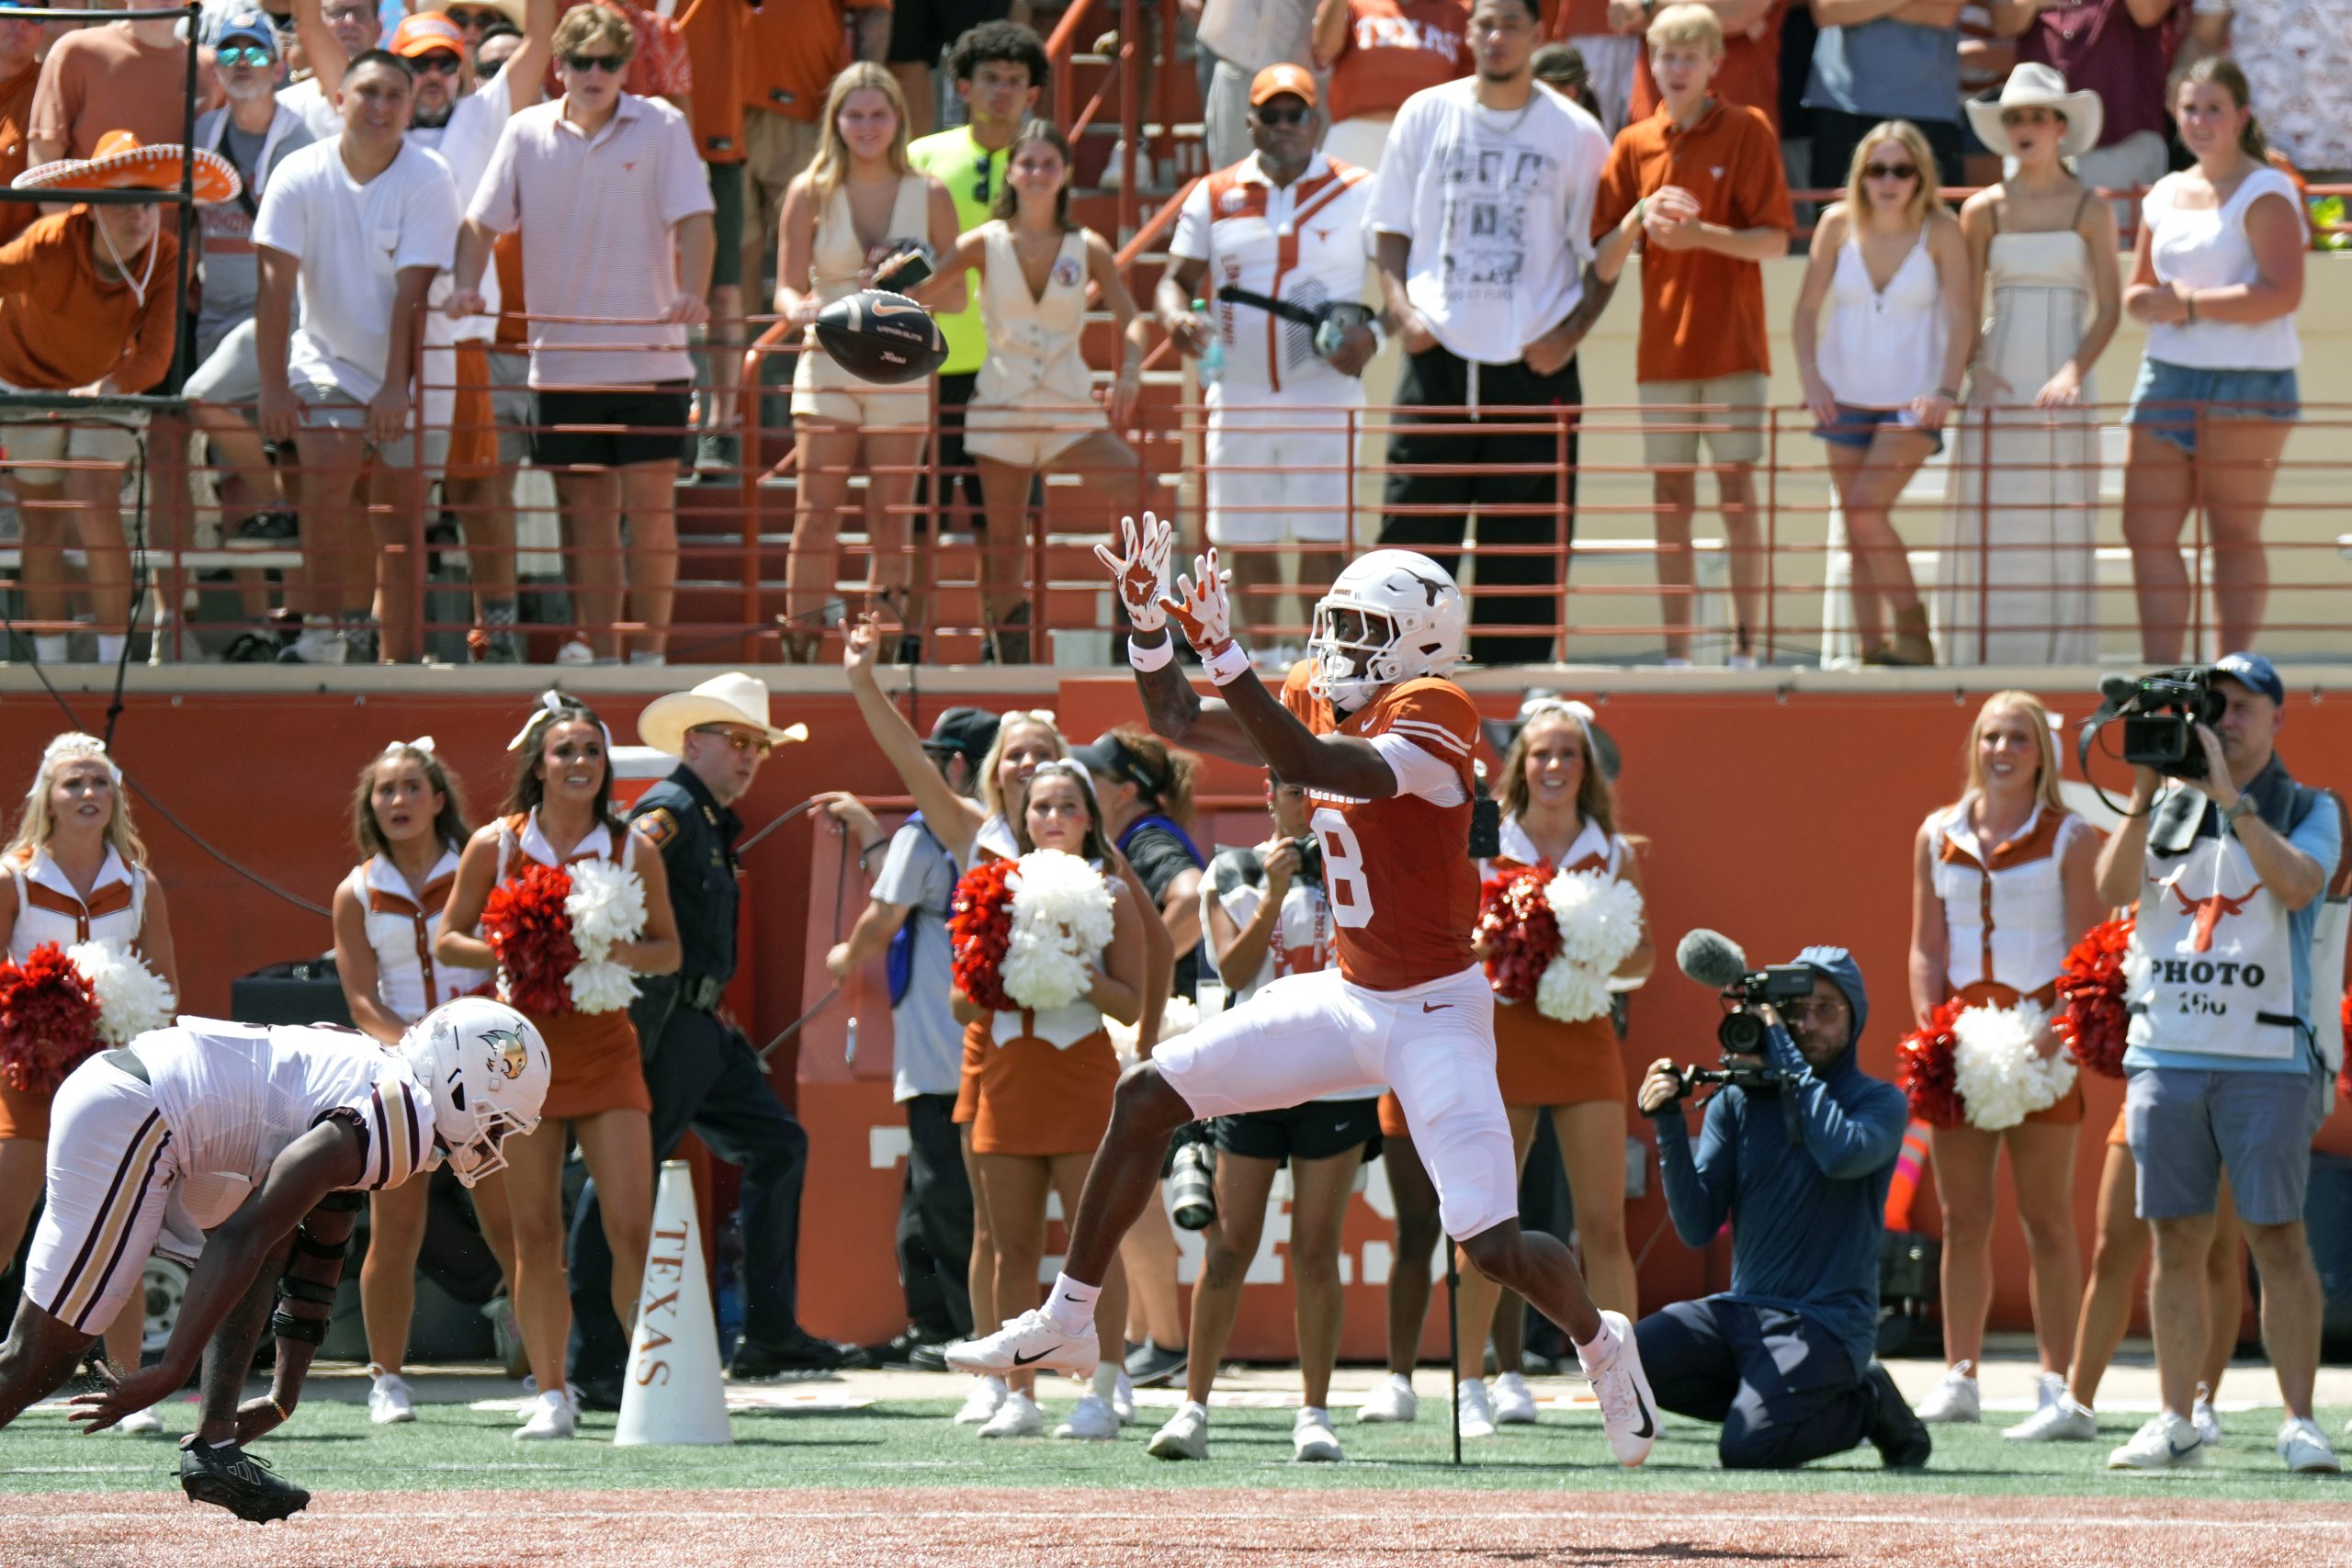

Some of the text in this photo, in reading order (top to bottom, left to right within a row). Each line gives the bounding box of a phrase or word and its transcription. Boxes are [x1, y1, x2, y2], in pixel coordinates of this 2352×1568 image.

[1220, 253, 1242, 348] LONRNS
[1310, 807, 1374, 929] 8
[2151, 961, 2266, 988] PHOTO
[636, 1220, 688, 1386] TEXAS
